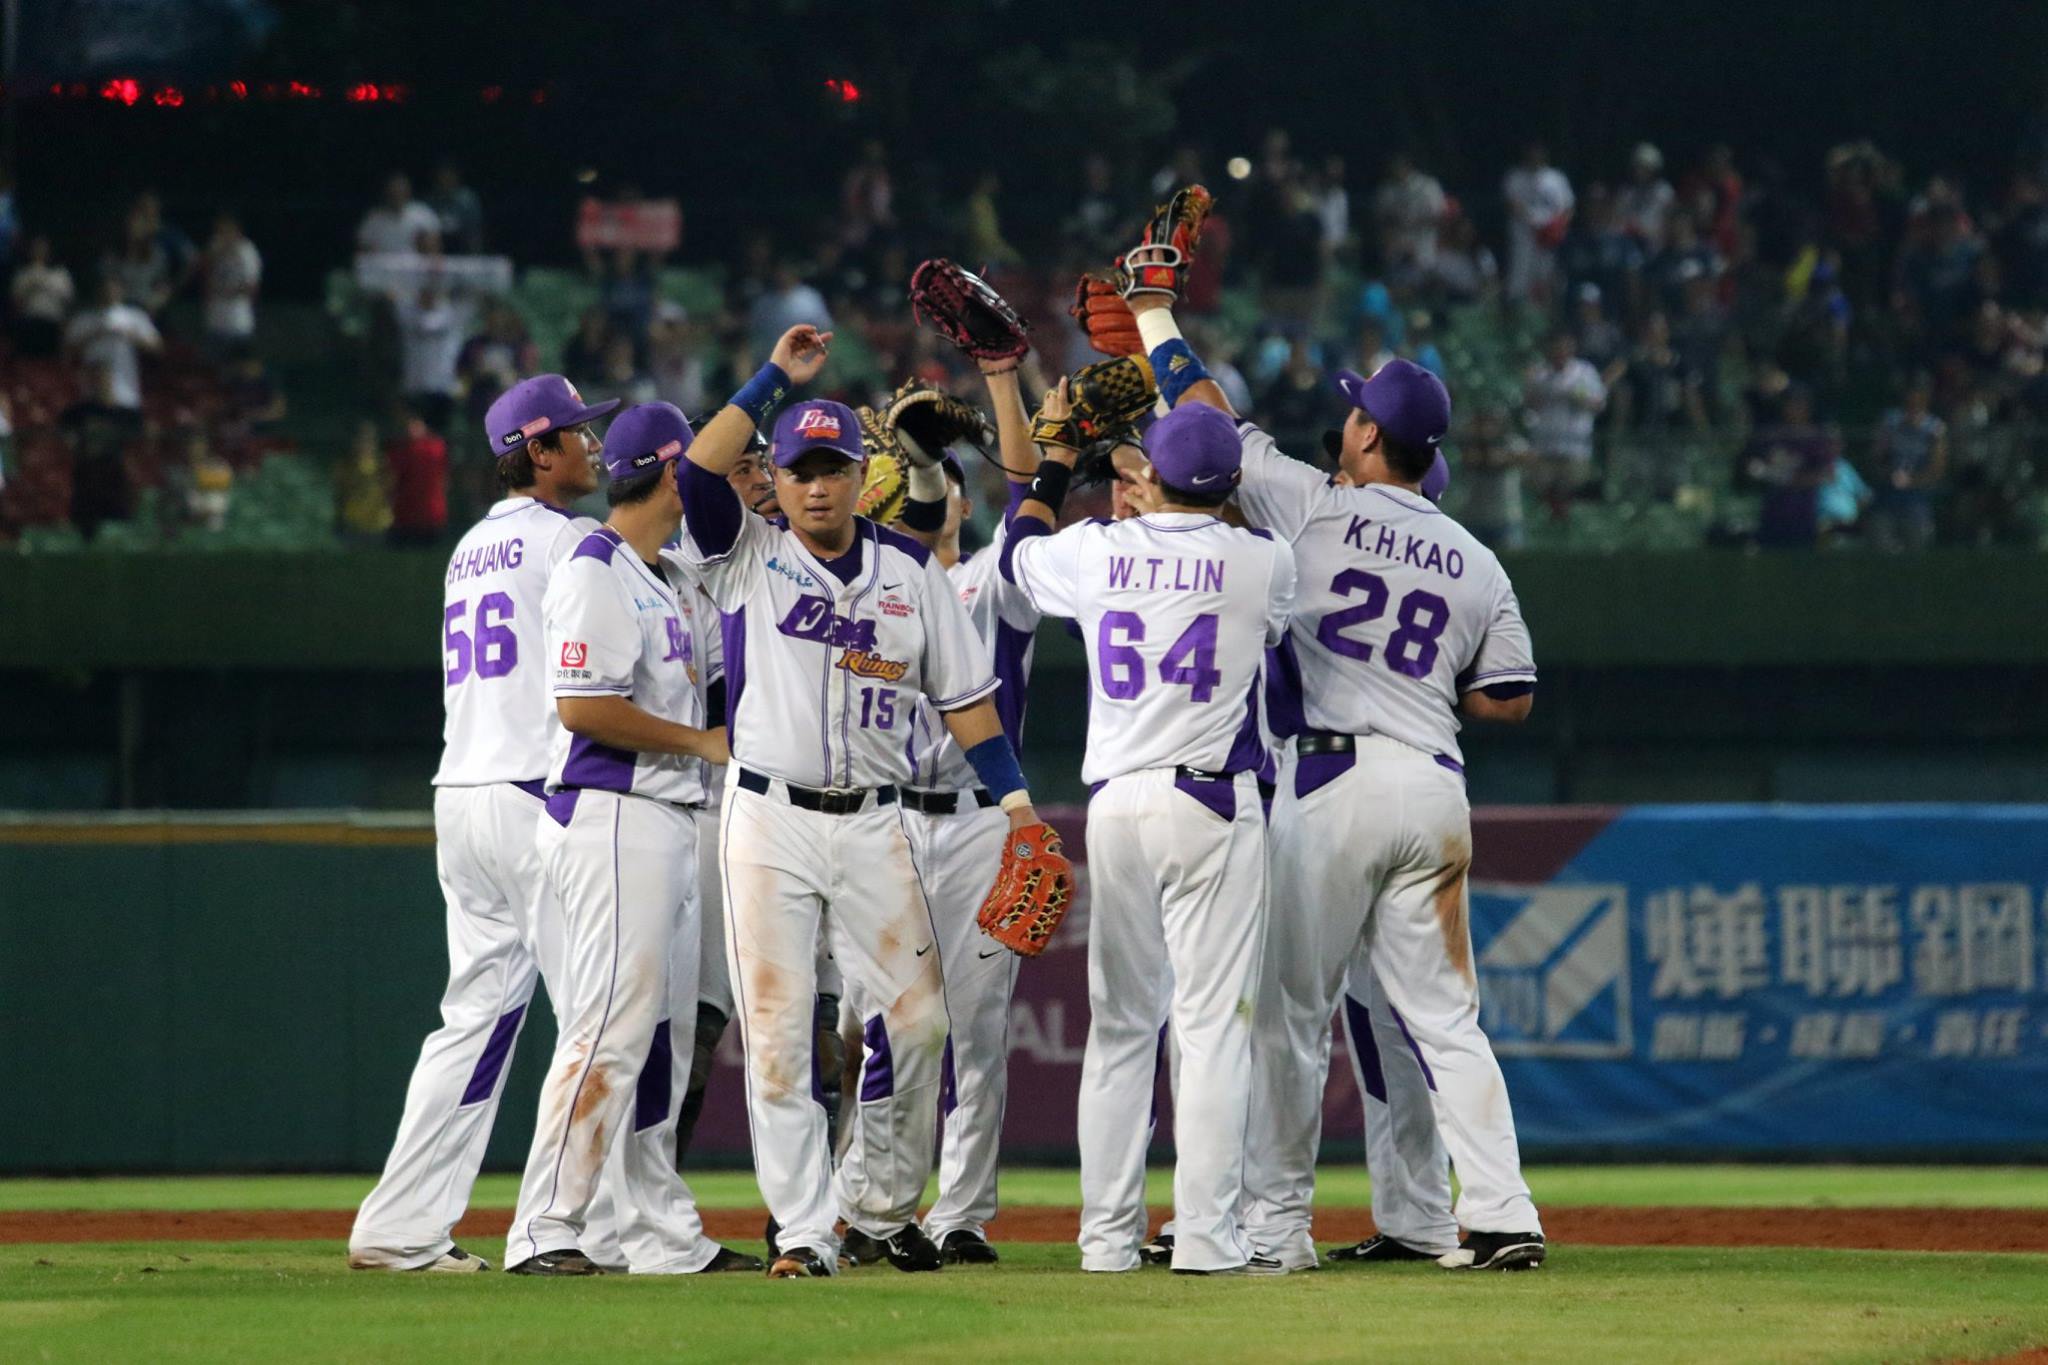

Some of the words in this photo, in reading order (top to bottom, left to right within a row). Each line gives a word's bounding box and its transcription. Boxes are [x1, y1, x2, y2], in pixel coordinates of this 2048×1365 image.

[1109, 555, 1225, 593] W.T.LIN
[1344, 514, 1464, 580] K.H.KAO
[445, 591, 518, 688] 56
[1099, 610, 1222, 703] 64
[1317, 568, 1450, 680] 28
[860, 687, 897, 730] 15
[1644, 881, 2048, 998] 燁聯鋼
